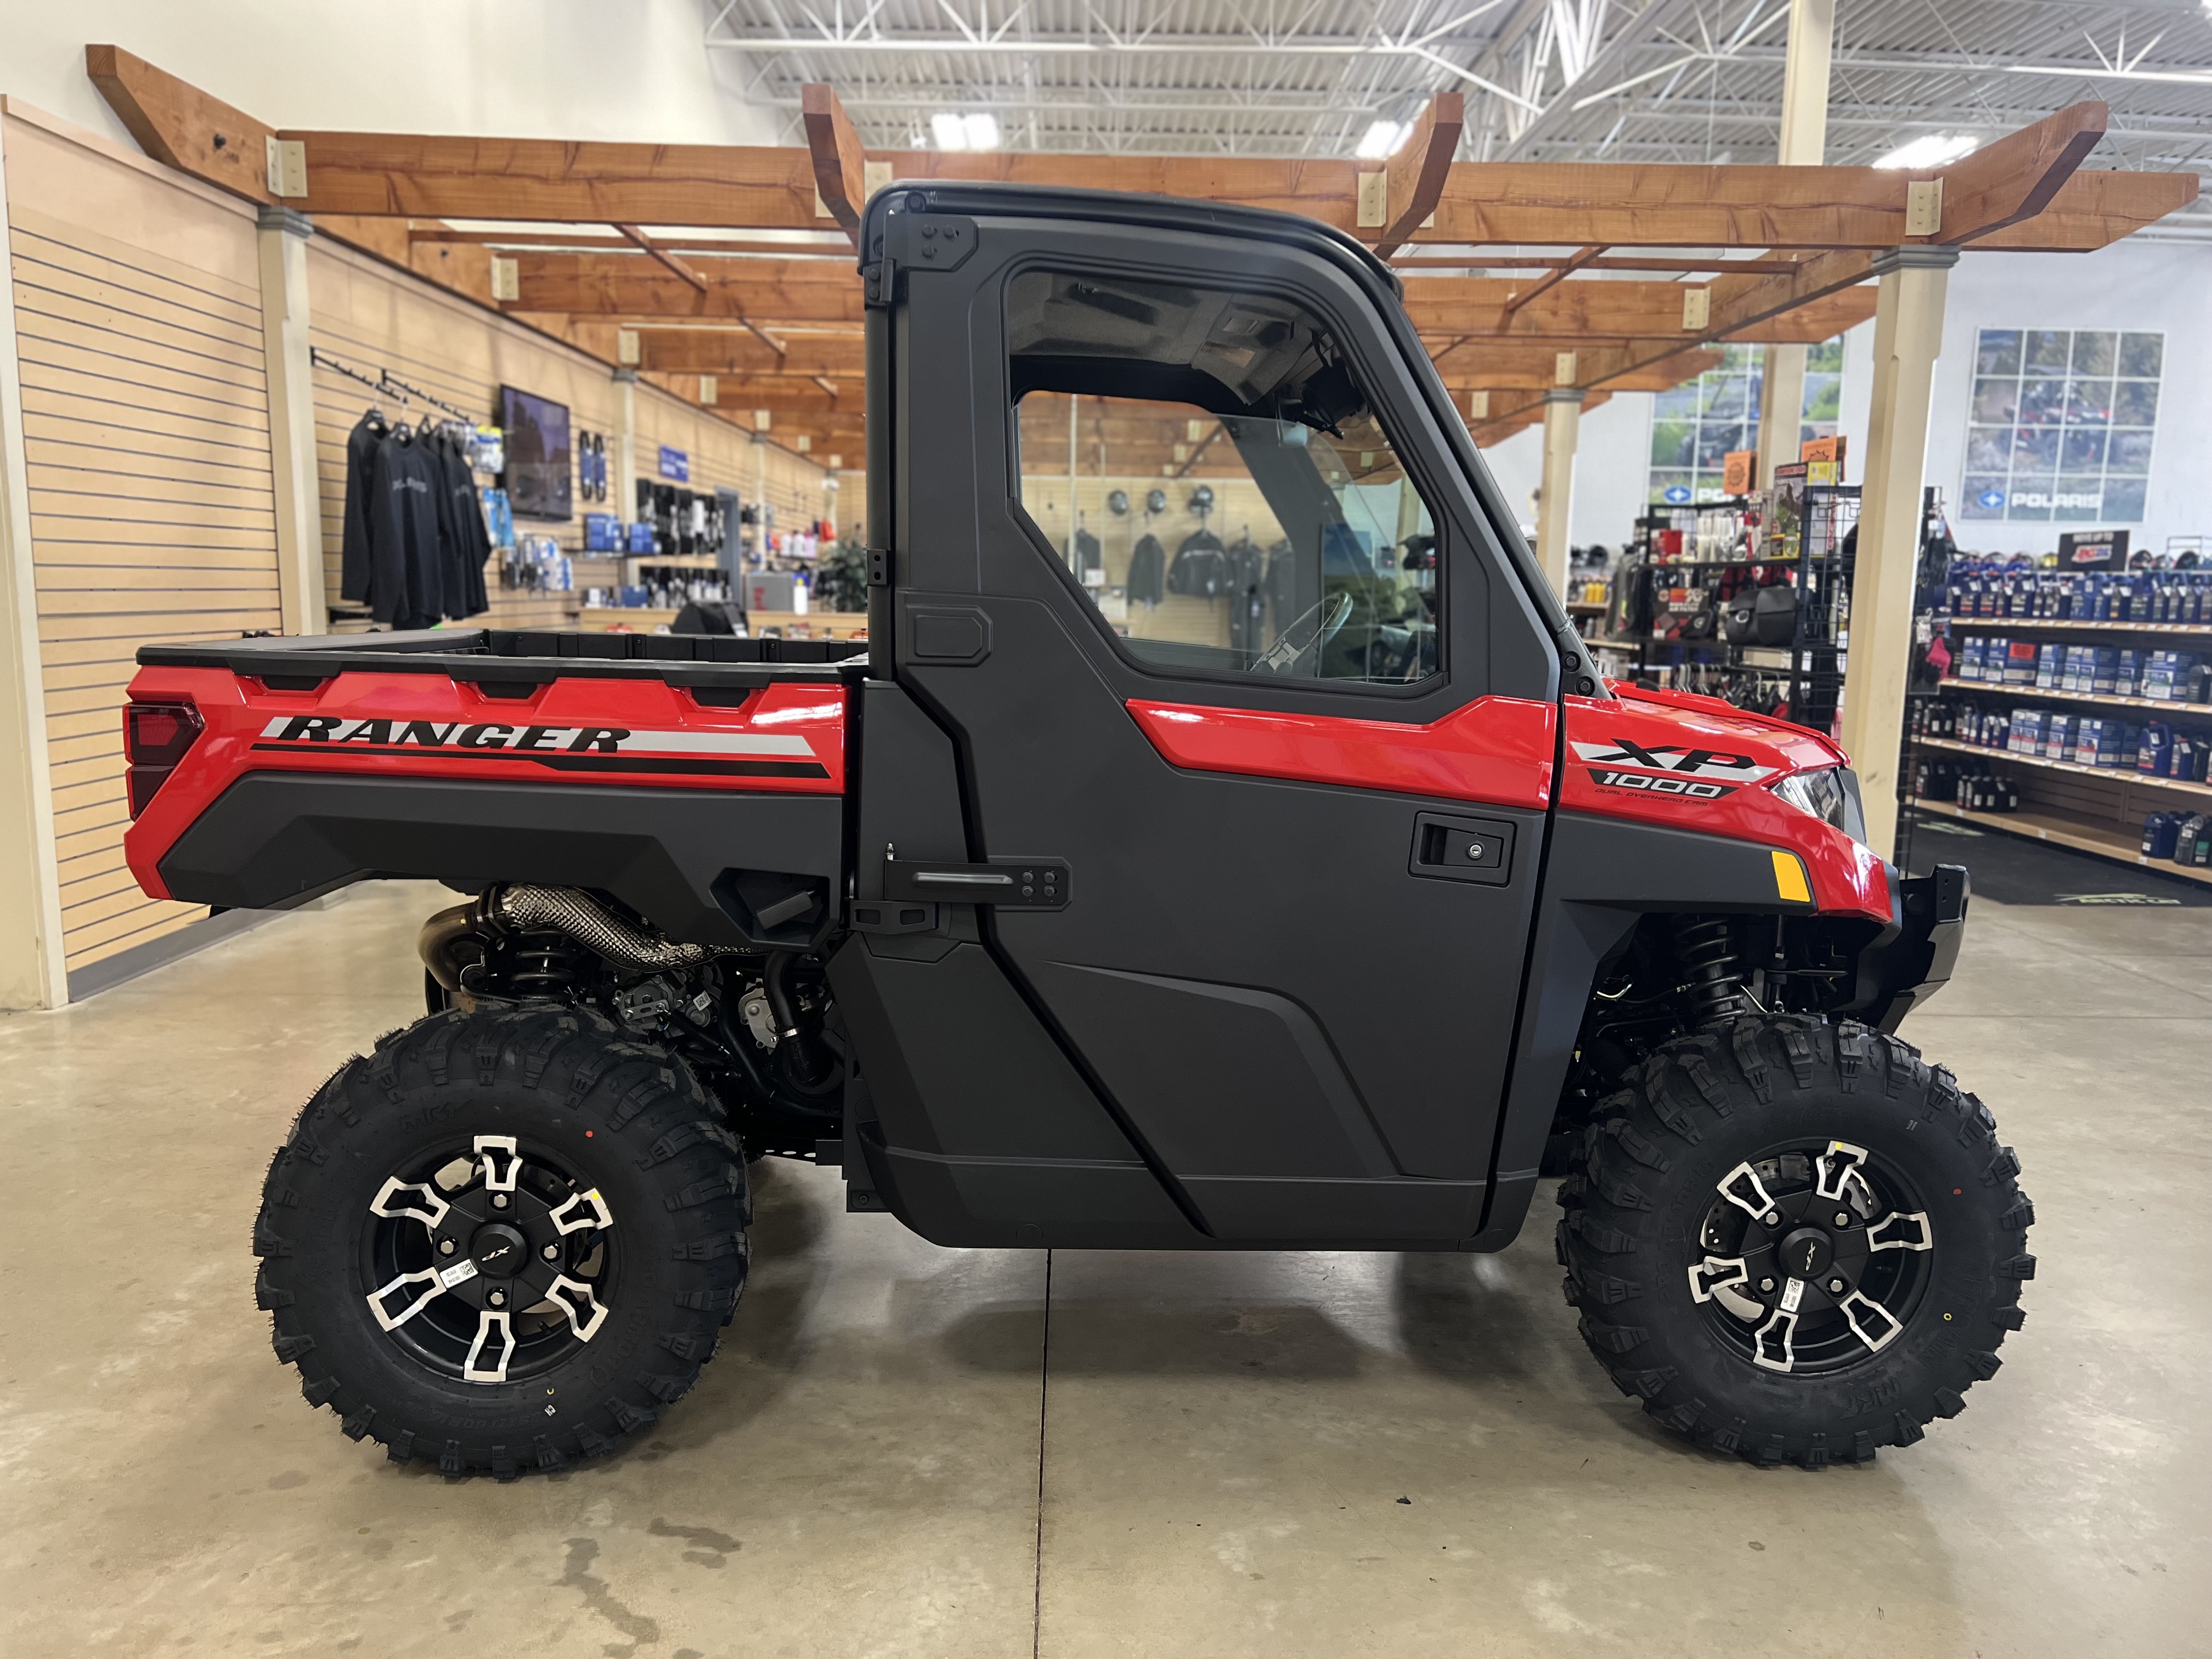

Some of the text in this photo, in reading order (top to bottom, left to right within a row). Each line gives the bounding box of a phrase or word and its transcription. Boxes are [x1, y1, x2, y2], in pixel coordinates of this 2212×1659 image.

[2011, 492, 2104, 509] POLARIS
[275, 715, 631, 754] RANGER
[1586, 738, 1758, 772] XP
[1602, 772, 1722, 798] 1000
[1626, 792, 1683, 803] OVERHEAD
[481, 1245, 511, 1261] XP
[1805, 1241, 1816, 1271] XP
